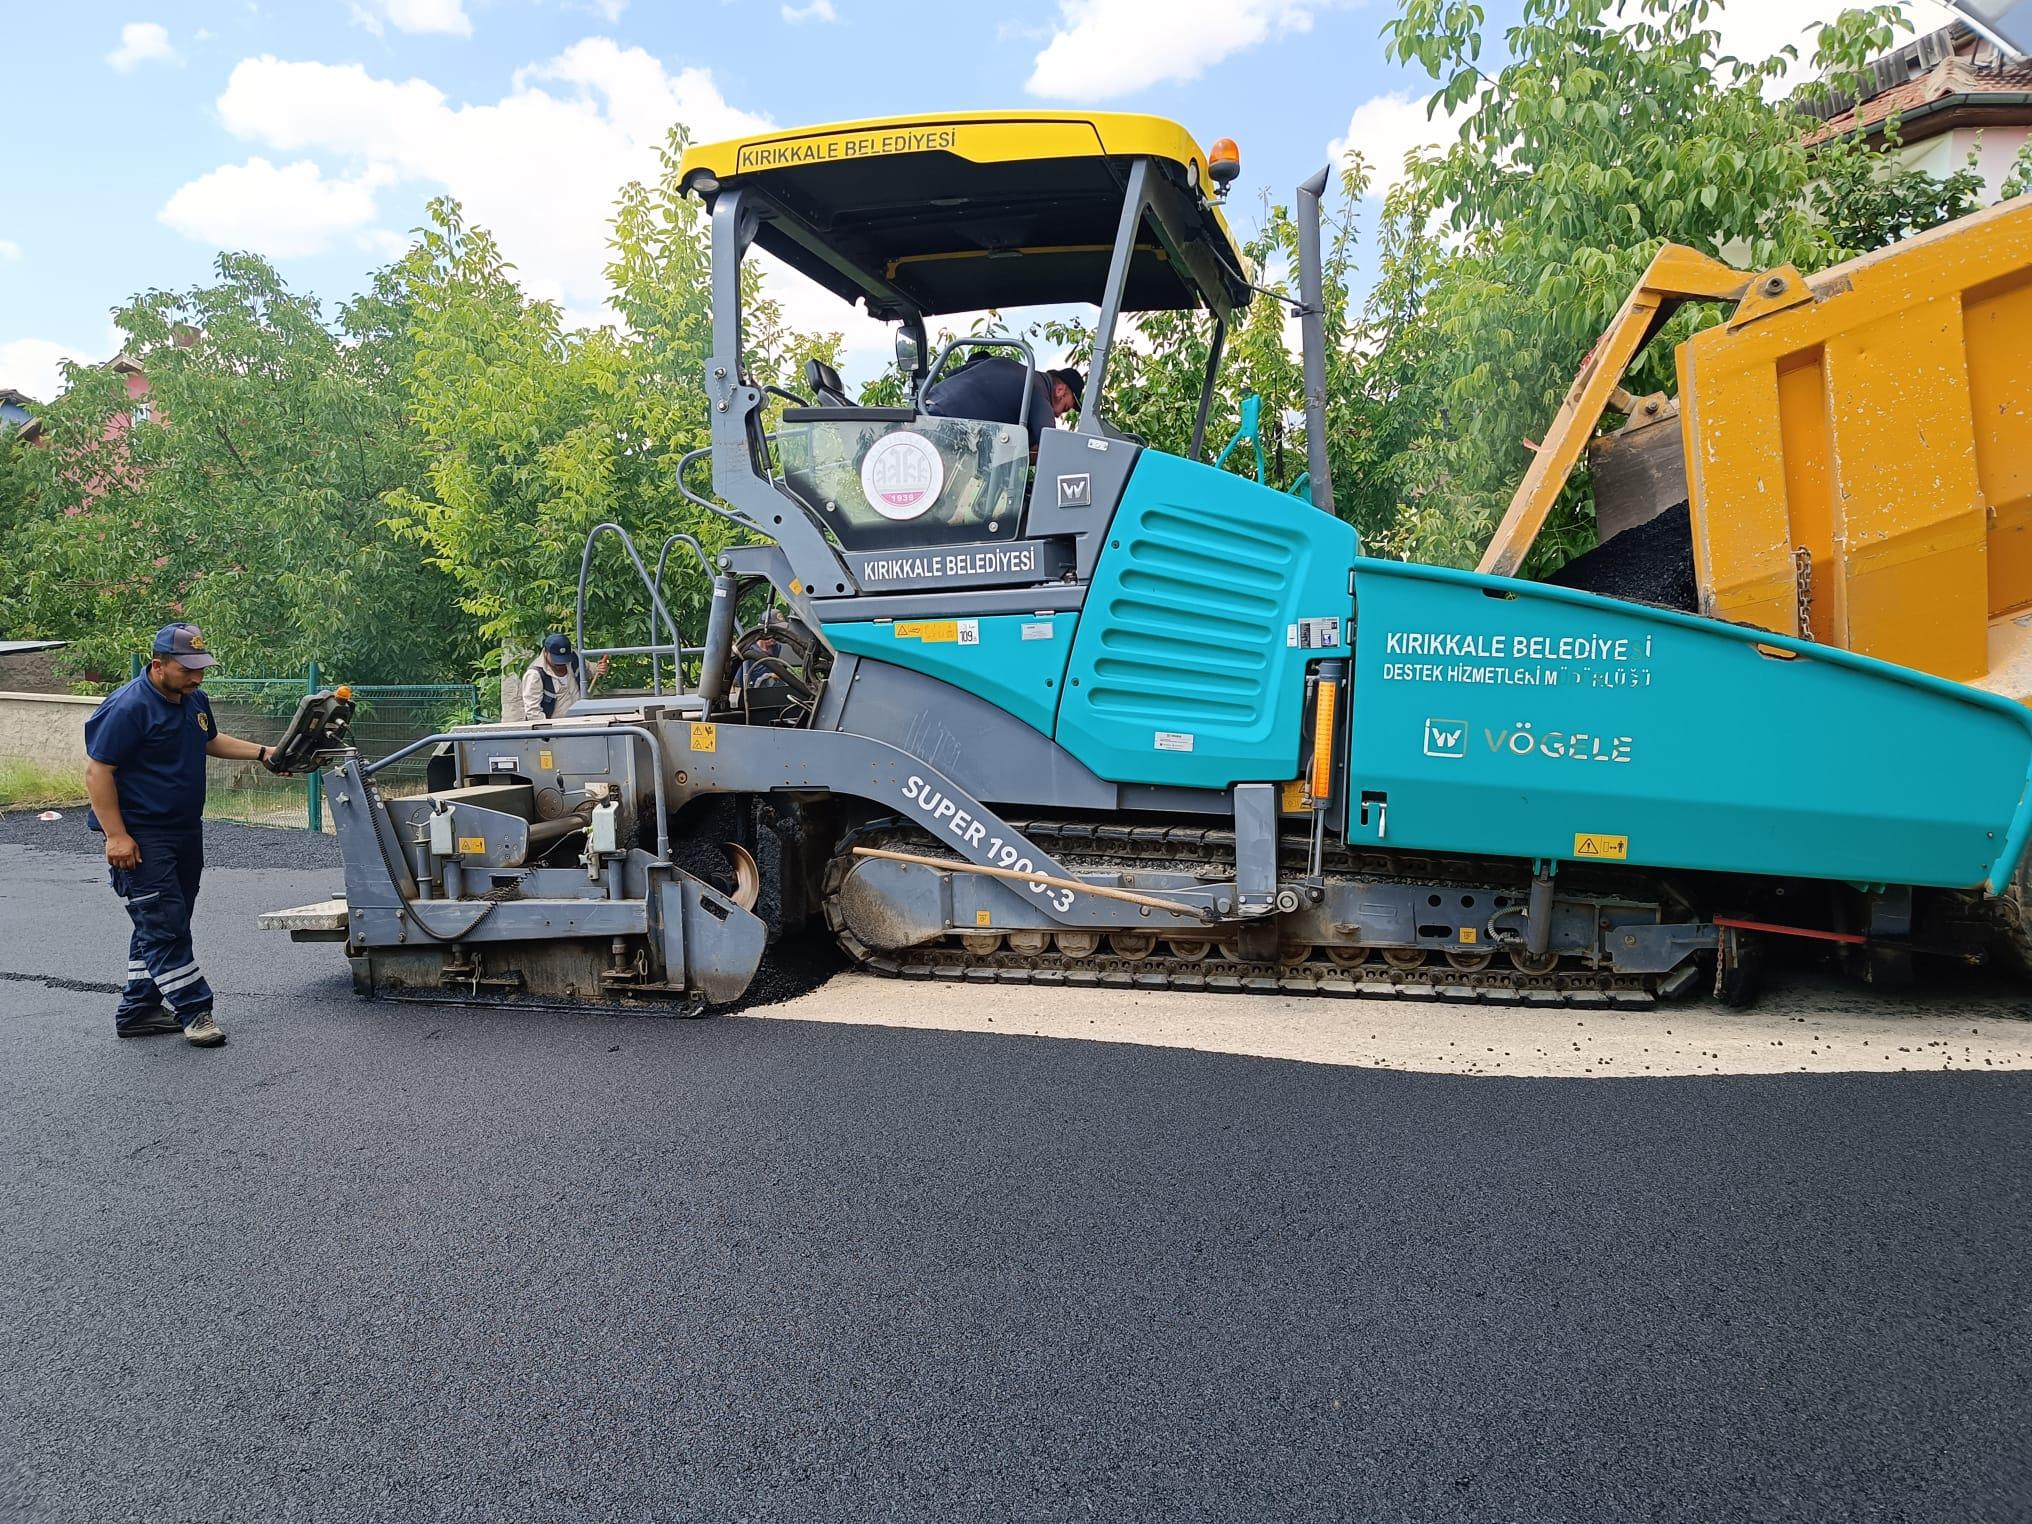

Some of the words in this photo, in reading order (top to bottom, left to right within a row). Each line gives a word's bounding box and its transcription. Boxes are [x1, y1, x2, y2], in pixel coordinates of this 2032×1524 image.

[742, 142, 838, 167] KIRIKKALE
[844, 128, 956, 157] BELEDİYESİ
[864, 557, 942, 581] KIRIKKALE
[946, 546, 1035, 575] BELEDİYESİ
[960, 630, 973, 642] 109
[1386, 632, 1506, 657] KIRIKKALE
[1512, 633, 1652, 661] BELEDİYEİ
[1383, 663, 1443, 682] DESTEK
[1484, 721, 1633, 763] VÖGELE
[901, 775, 986, 849] SUPER
